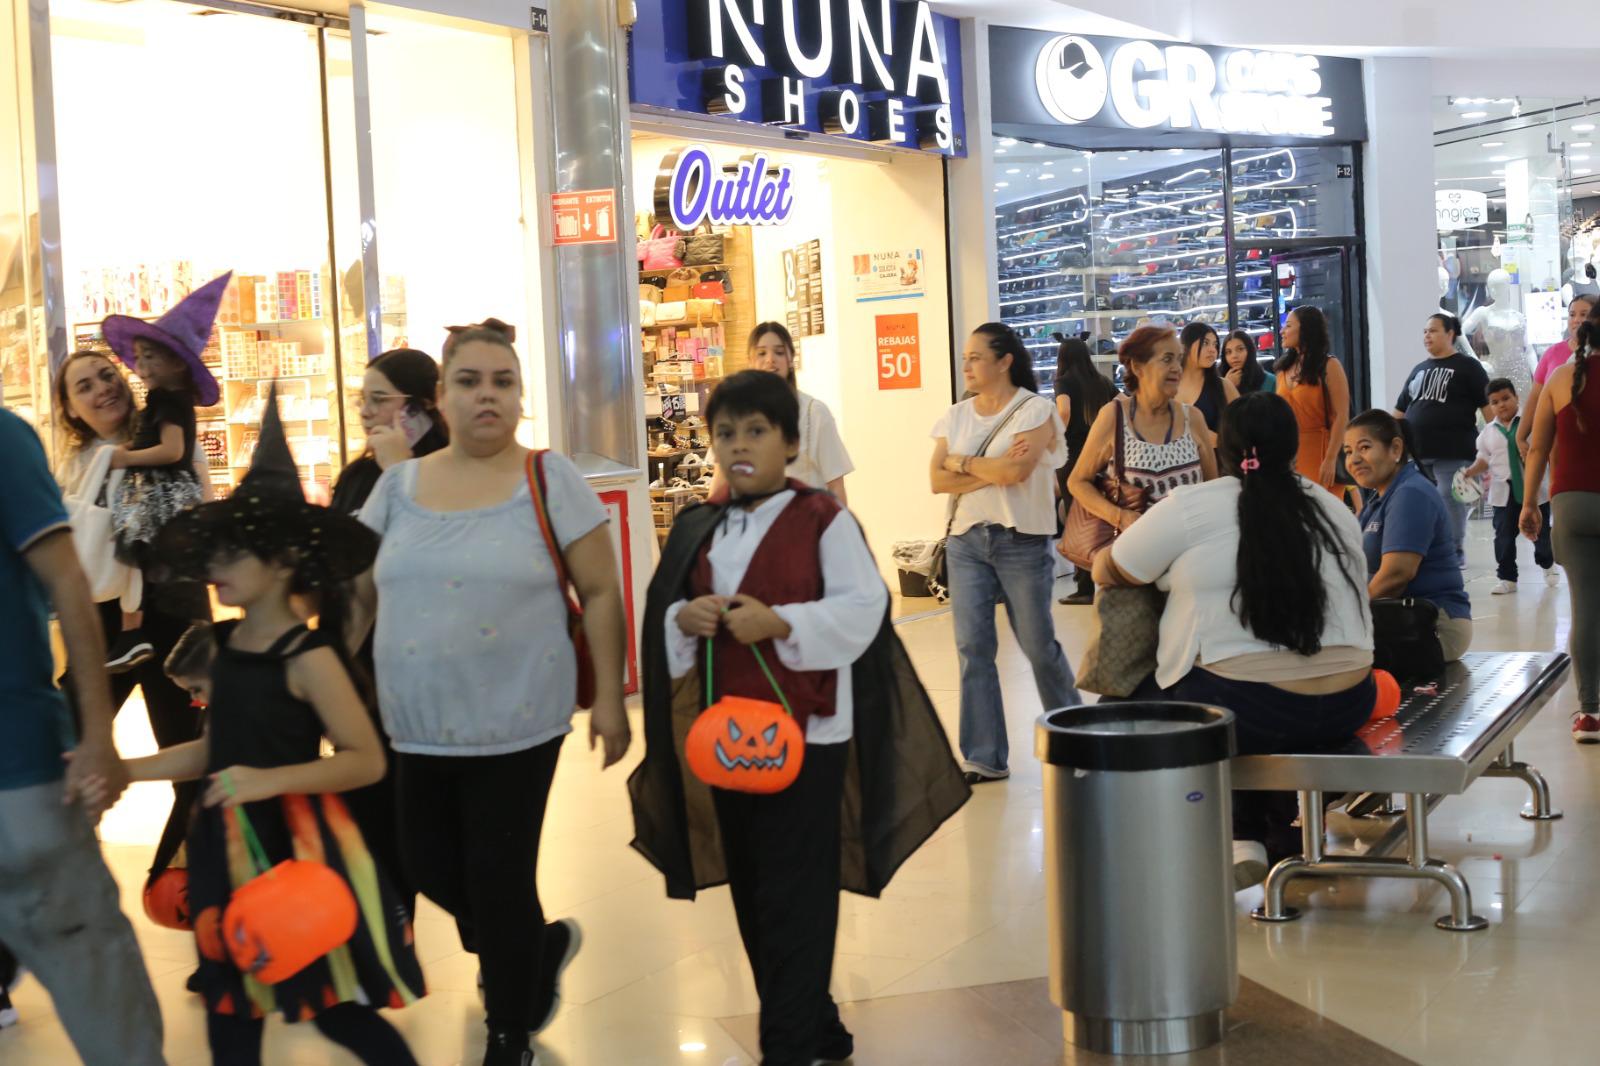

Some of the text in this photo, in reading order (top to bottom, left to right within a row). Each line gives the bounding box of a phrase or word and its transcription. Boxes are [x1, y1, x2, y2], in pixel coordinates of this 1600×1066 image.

[708, 0, 950, 104] NUNA
[724, 64, 951, 149] SHOES
[1337, 167, 1351, 176] F-12
[672, 147, 794, 227] Outlet
[873, 251, 900, 261] NUNA
[878, 335, 917, 347] REBAJAS
[881, 351, 912, 379] 50
